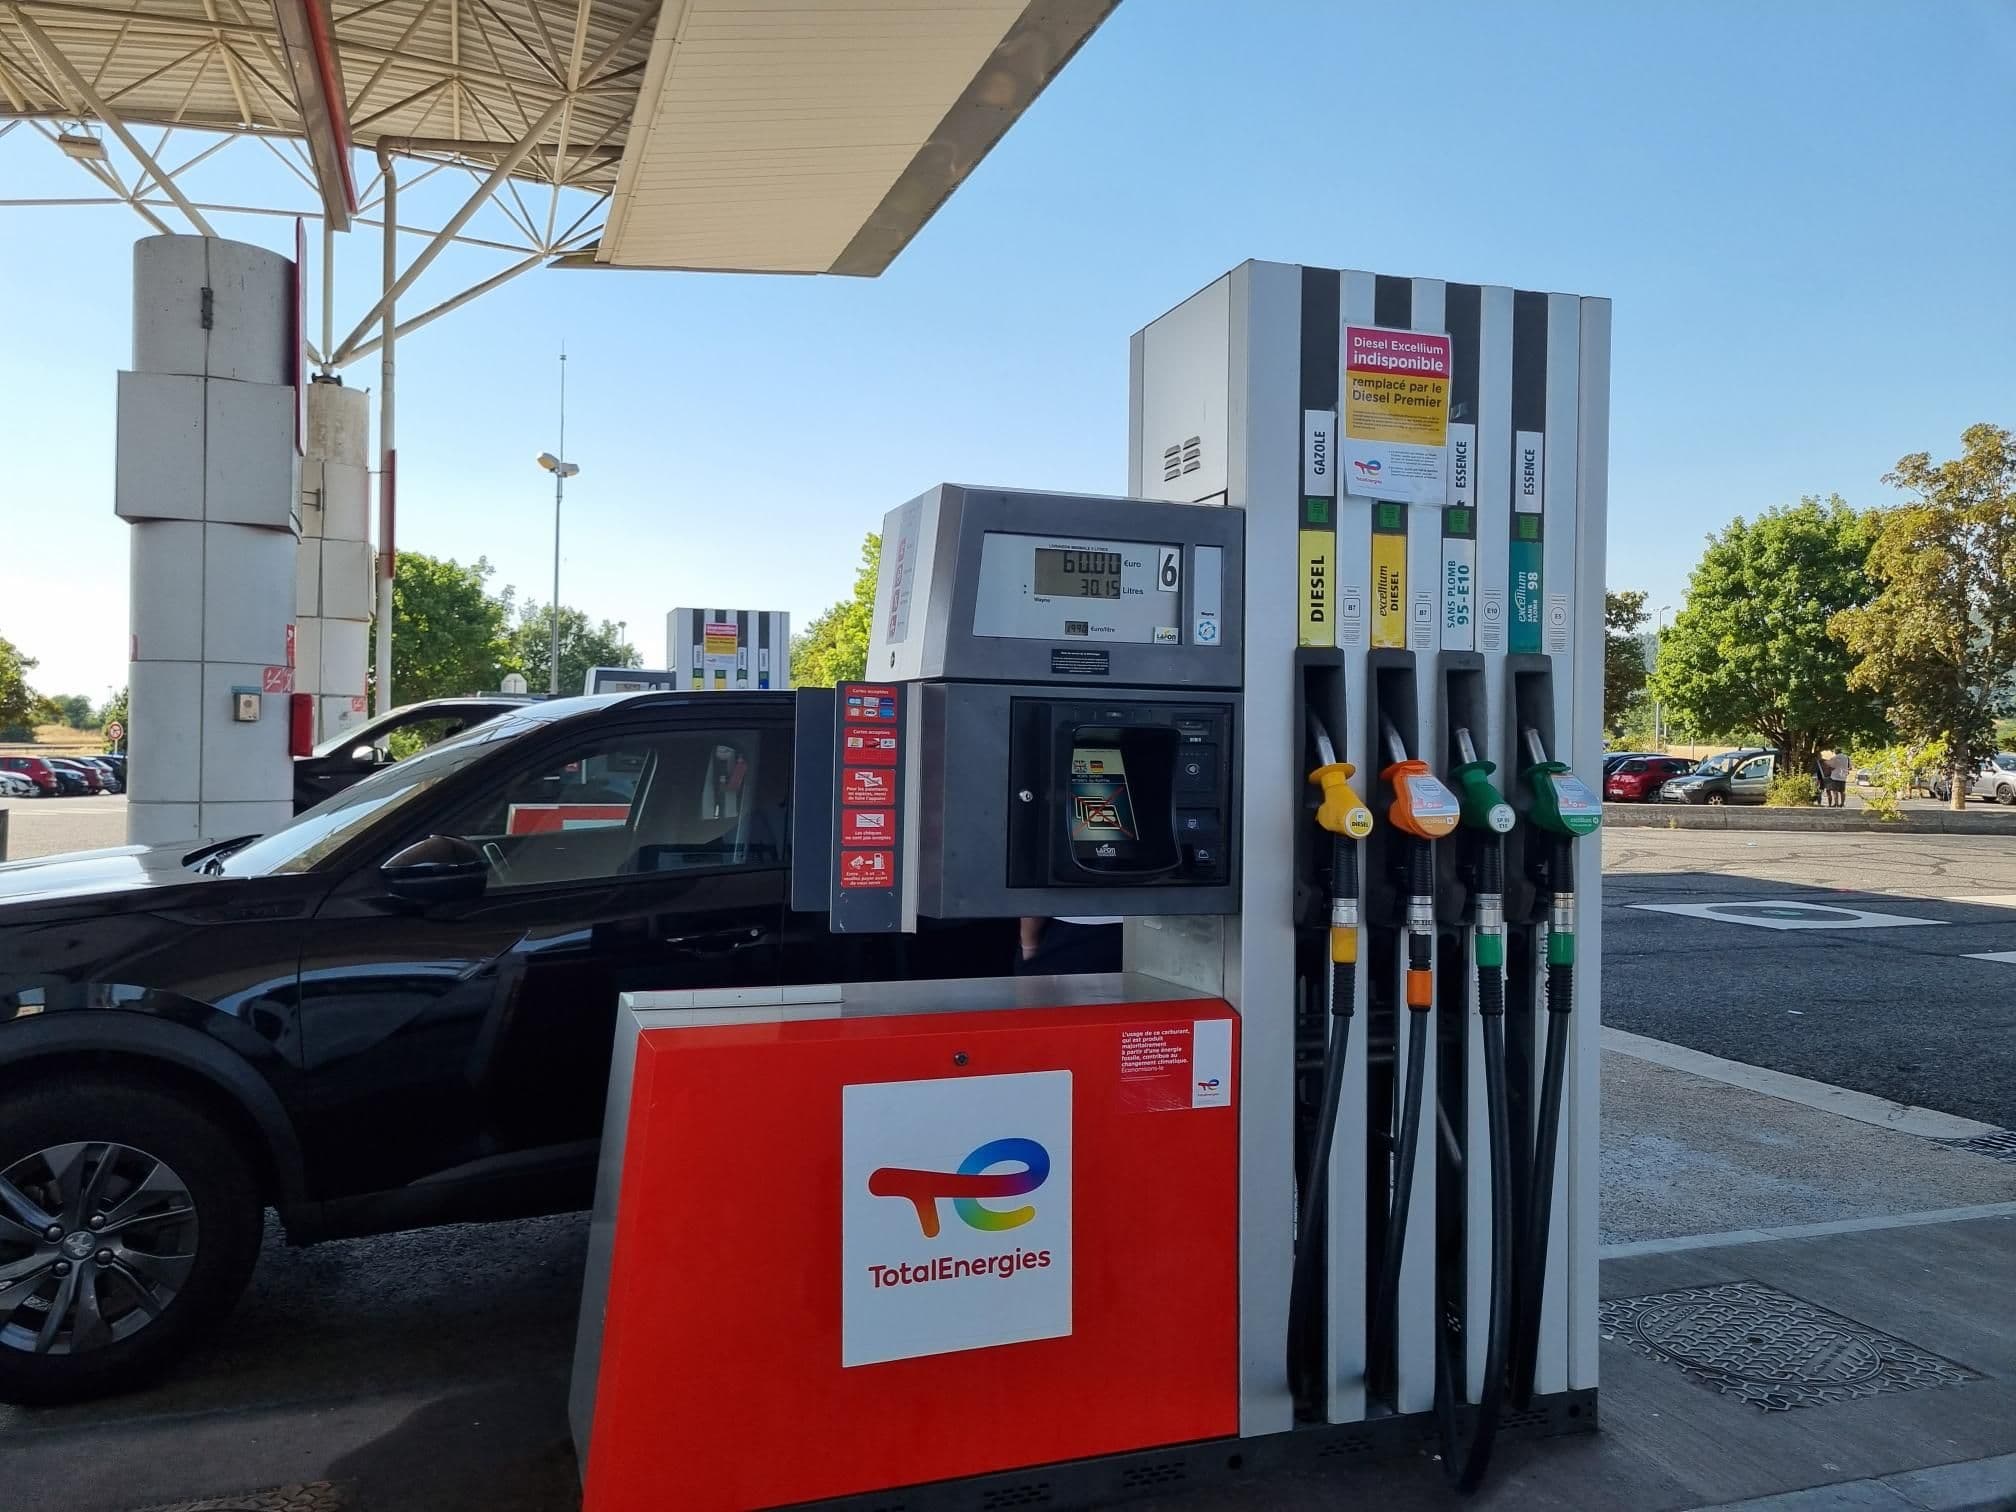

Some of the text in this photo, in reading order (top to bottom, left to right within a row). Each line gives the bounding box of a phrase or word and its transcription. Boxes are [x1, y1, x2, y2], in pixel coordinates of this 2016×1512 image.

[1354, 336, 1444, 355] Diesel Excellium
[1354, 350, 1444, 372] indisponible
[1352, 390, 1442, 408] Diesel Premier
[1353, 378, 1442, 394] remplacé par le
[1313, 431, 1326, 476] GAZOLE
[1455, 440, 1467, 489] ESSENCE
[1523, 448, 1535, 496] ESSENCE
[1161, 553, 1177, 587] 6
[1310, 555, 1325, 622] DIESEL
[1527, 571, 1538, 591] 98
[1122, 586, 1144, 596] Litres
[1377, 565, 1388, 617] excellium
[1390, 571, 1399, 612] DIESEL
[1447, 560, 1457, 629] SANS PLOMB
[1514, 571, 1527, 623] excellium
[1351, 821, 1369, 829] DIESEL
[1121, 1060, 1156, 1068] changement
[868, 1248, 1051, 1288] TotalEnergies
